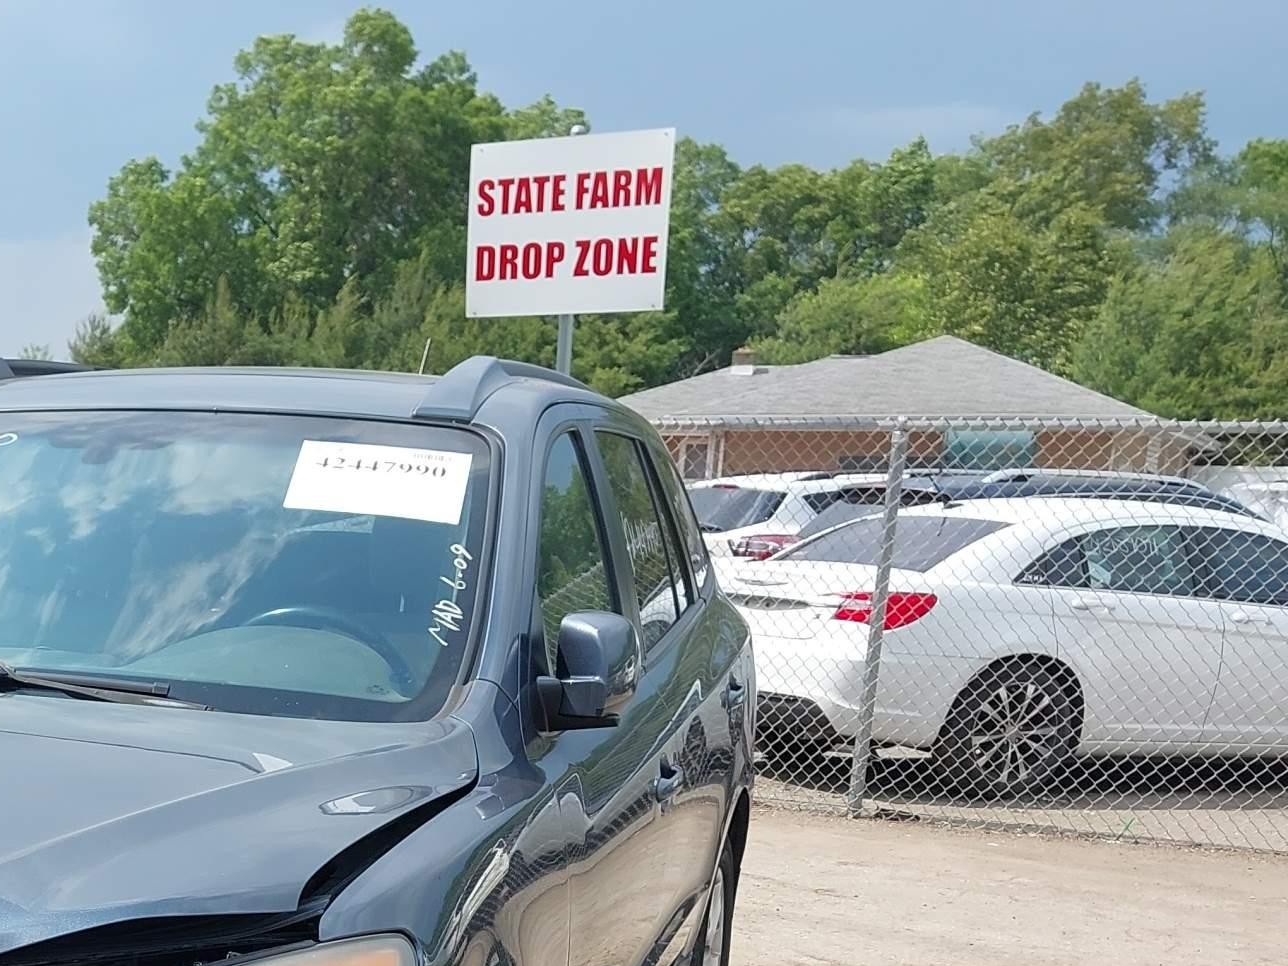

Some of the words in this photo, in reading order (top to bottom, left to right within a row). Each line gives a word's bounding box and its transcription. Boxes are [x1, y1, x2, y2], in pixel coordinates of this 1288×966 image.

[477, 175, 566, 217] STATE
[575, 167, 663, 210] FARM
[475, 241, 565, 281] DROP
[573, 236, 658, 277] ZONE
[315, 456, 448, 478] 42447990
[439, 543, 473, 590] 6-09
